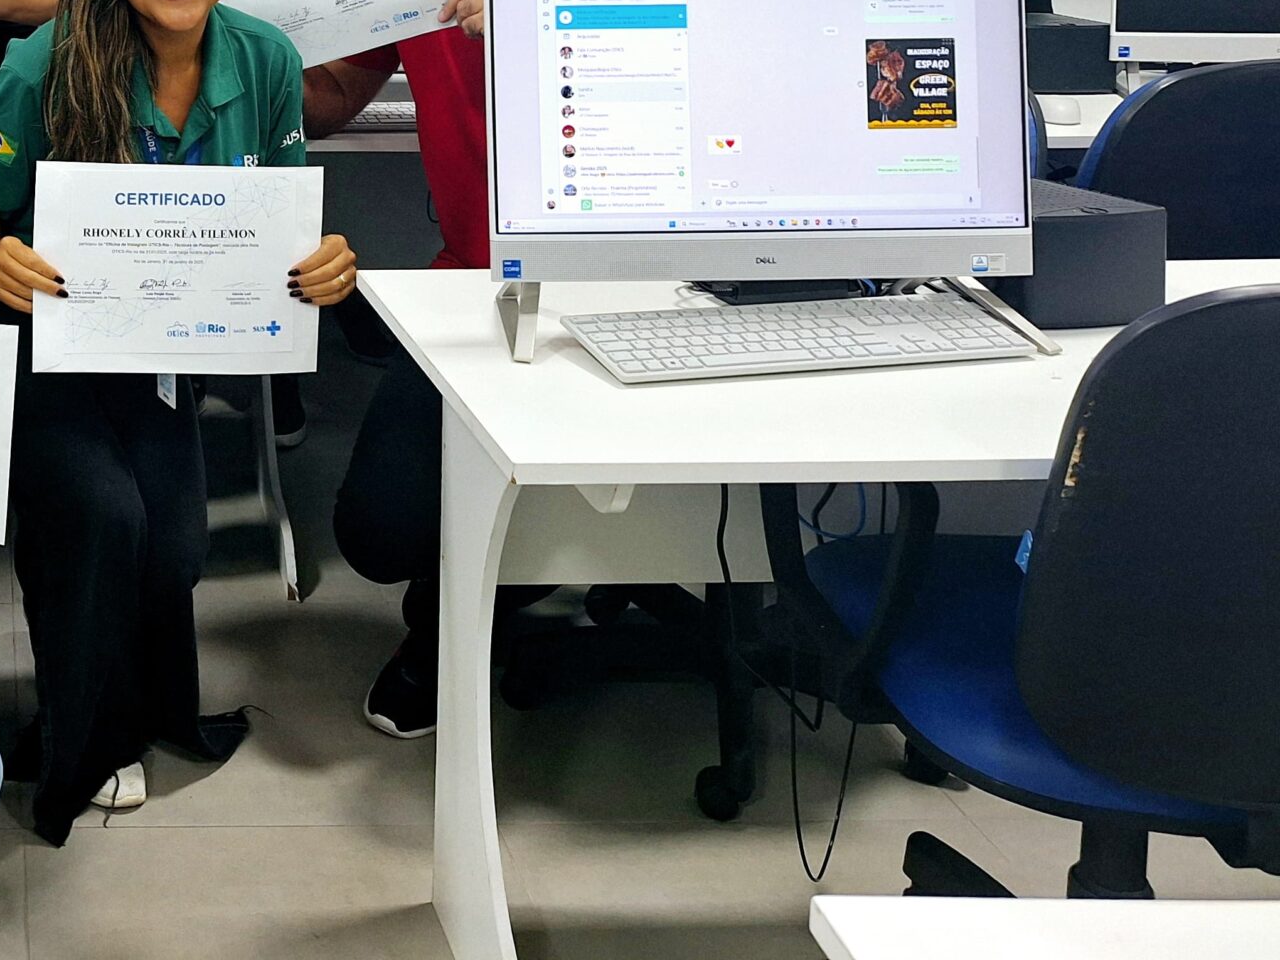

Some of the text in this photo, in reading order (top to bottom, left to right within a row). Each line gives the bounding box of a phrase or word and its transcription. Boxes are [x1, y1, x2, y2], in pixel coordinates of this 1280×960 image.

[402, 9, 419, 21] Rio
[915, 60, 950, 71] ESPAÇO
[919, 75, 948, 84] GREEN
[913, 87, 948, 96] VILLAGE
[115, 192, 226, 206] CERTIFICADO
[82, 226, 256, 239] RHONELY CORRÊA FILEMON
[755, 256, 777, 265] DELL
[166, 327, 190, 338] otics
[207, 323, 226, 334] Rio
